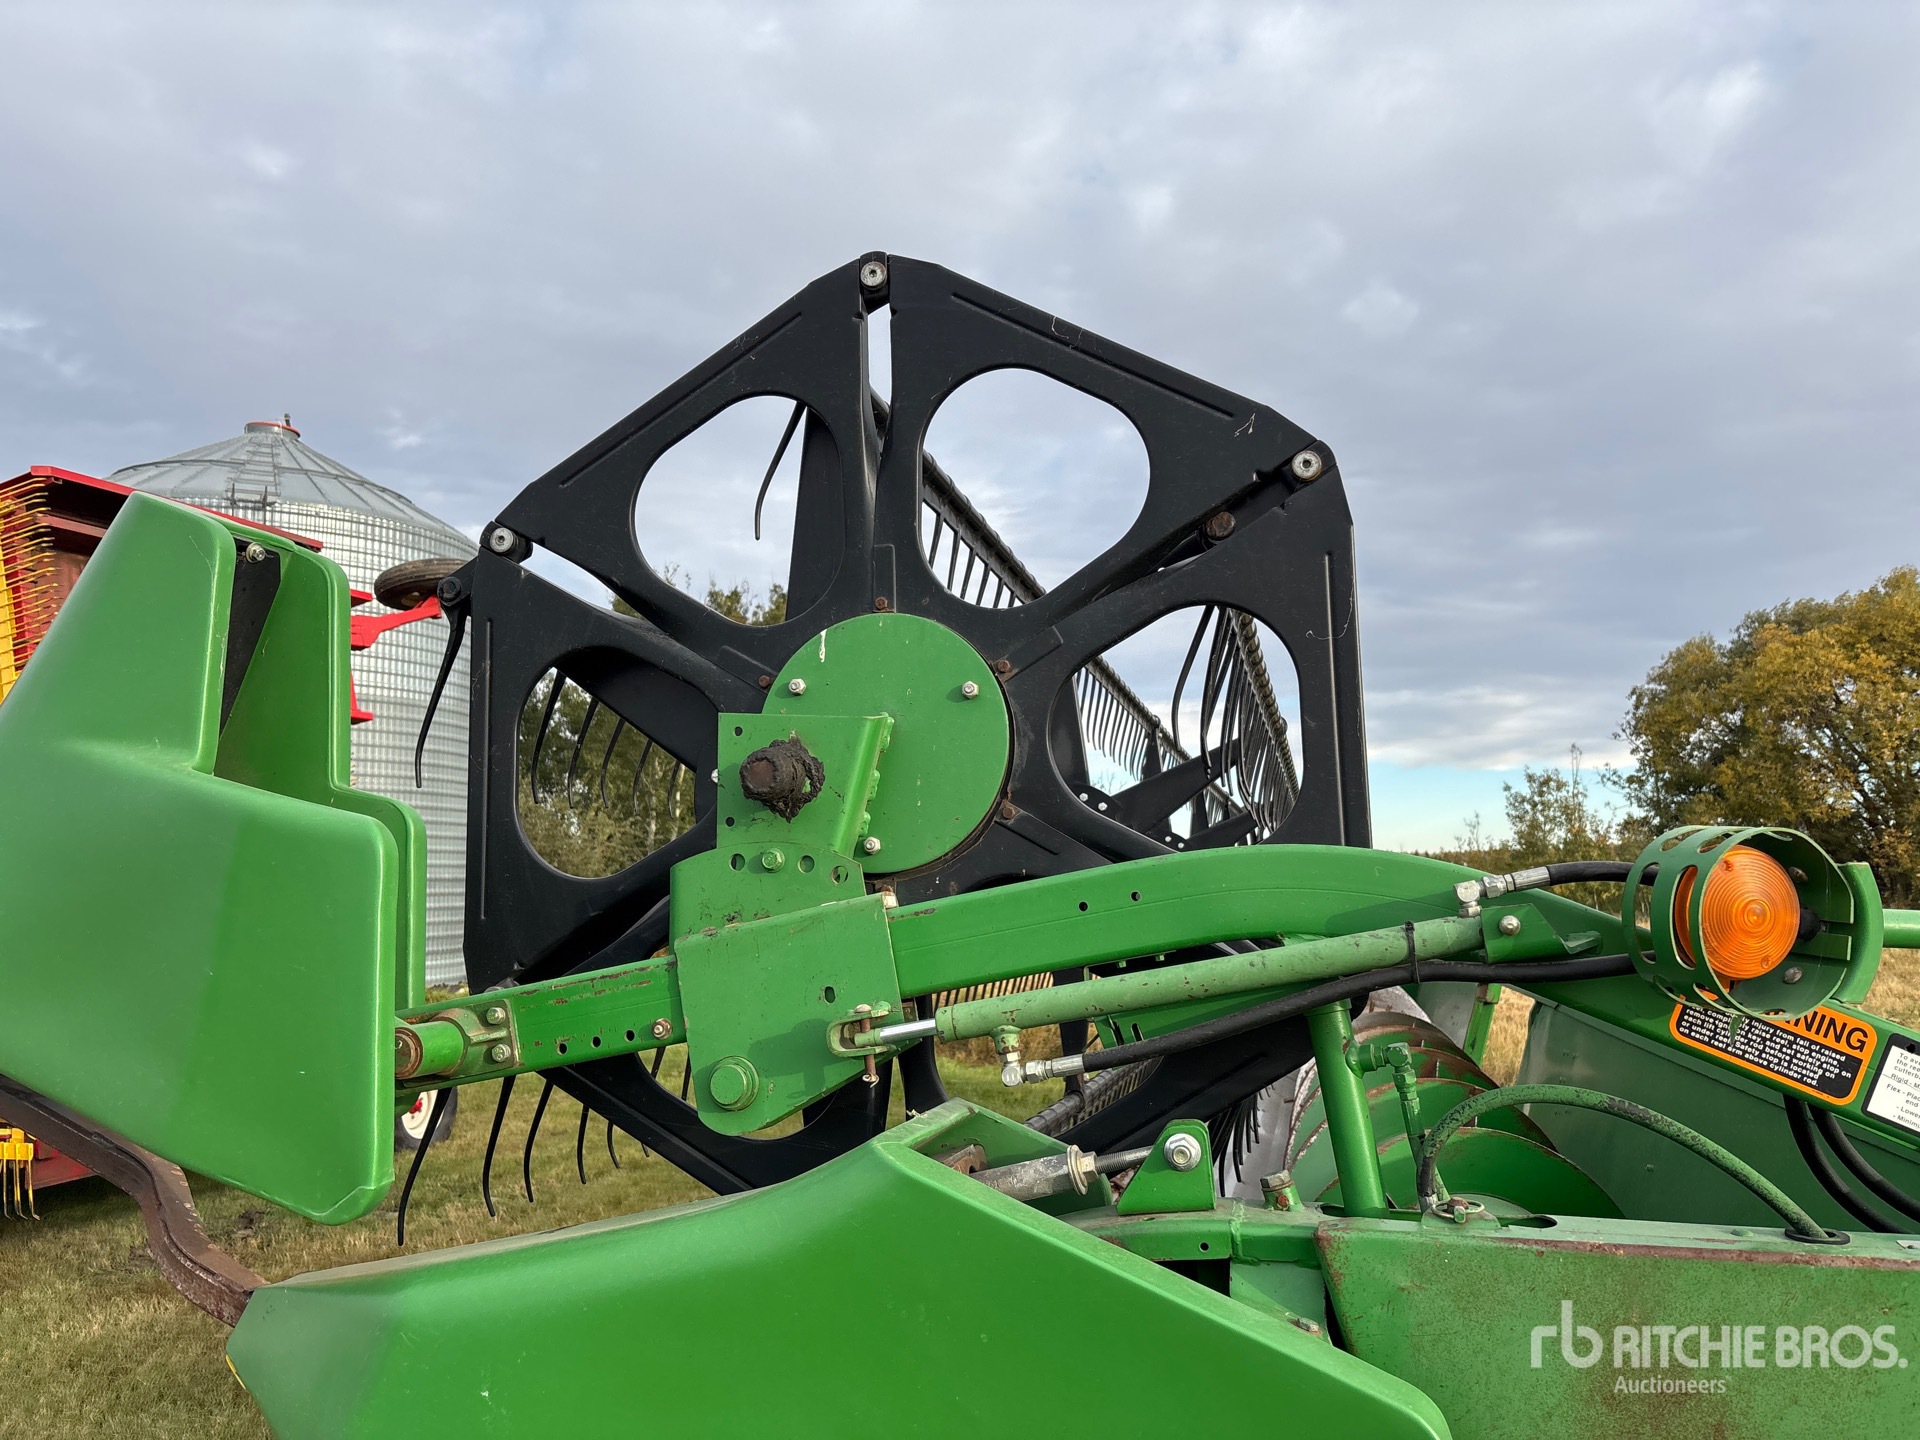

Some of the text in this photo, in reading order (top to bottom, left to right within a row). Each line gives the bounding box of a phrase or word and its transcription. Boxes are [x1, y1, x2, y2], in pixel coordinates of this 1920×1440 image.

[1683, 1015, 1702, 1025] each
[1703, 1022, 1715, 1030] lift
[1750, 1041, 1764, 1050] rod
[1765, 1046, 1790, 1060] before
[1792, 1058, 1823, 1075] working
[1825, 1071, 1836, 1079] on
[1686, 1009, 1714, 1023] remove
[1765, 1040, 1781, 1050] and
[1782, 1047, 1795, 1056] set
[1796, 1052, 1821, 1066] safety
[1822, 1062, 1840, 1074] stop
[1841, 1070, 1852, 1078] on
[1691, 1025, 1714, 1037] under
[1735, 1041, 1760, 1056] Safety
[1761, 1053, 1779, 1063] stop
[1790, 1063, 1820, 1079] located
[1751, 1020, 1846, 1062] injury from fall of raised
[1751, 1028, 1771, 1039] raise
[1792, 1044, 1810, 1055] stop
[1690, 1031, 1709, 1042] each
[1710, 1039, 1726, 1049] reel
[1727, 1046, 1743, 1056] arm
[1744, 1053, 1768, 1065] above
[1769, 1063, 1803, 1079] cylinder
[1803, 1076, 1819, 1087] rod.
[1896, 1058, 1908, 1067] the
[1899, 1052, 1909, 1061] To
[1886, 1083, 1901, 1094] Flex
[1890, 1073, 1909, 1085] Rigid
[1905, 1099, 1919, 1108] end
